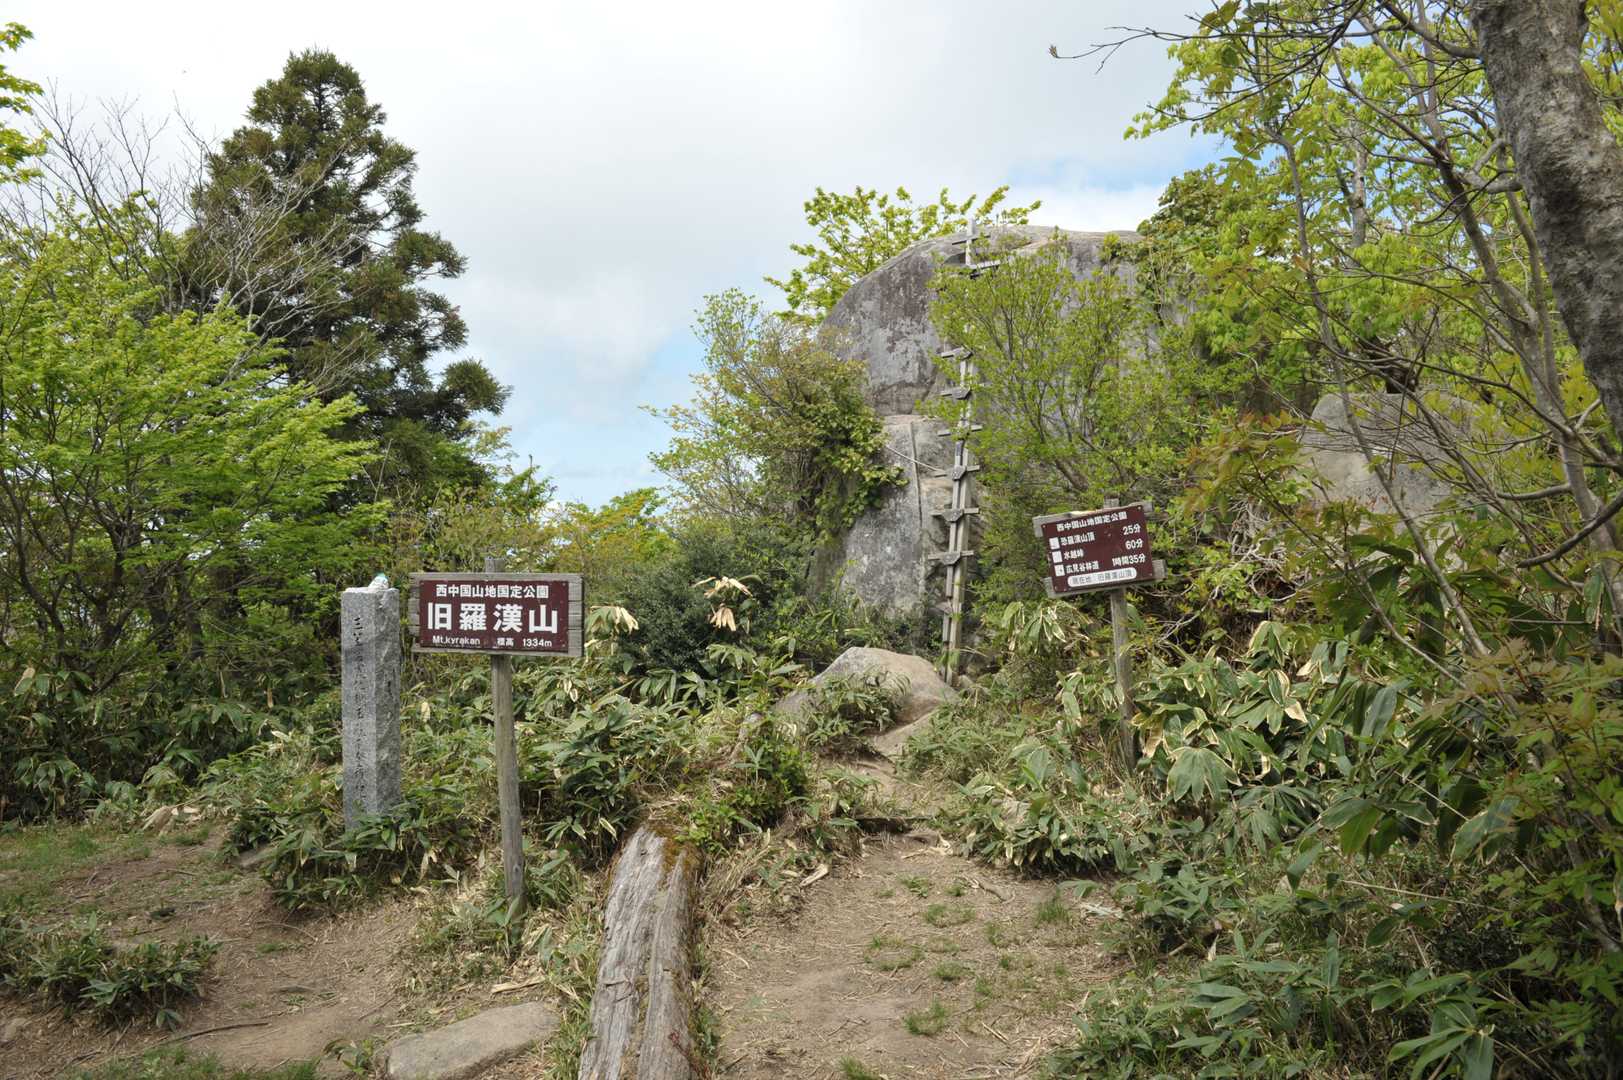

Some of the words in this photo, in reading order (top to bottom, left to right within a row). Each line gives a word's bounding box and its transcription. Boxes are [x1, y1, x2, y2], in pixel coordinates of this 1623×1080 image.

[1122, 523, 1141, 536] 25分
[1125, 538, 1143, 550] 60分
[435, 584, 549, 599] 西中国山地国定公園
[427, 602, 558, 634] 旧羅漢山
[497, 637, 514, 647] 標高
[523, 638, 552, 648] 1334m
